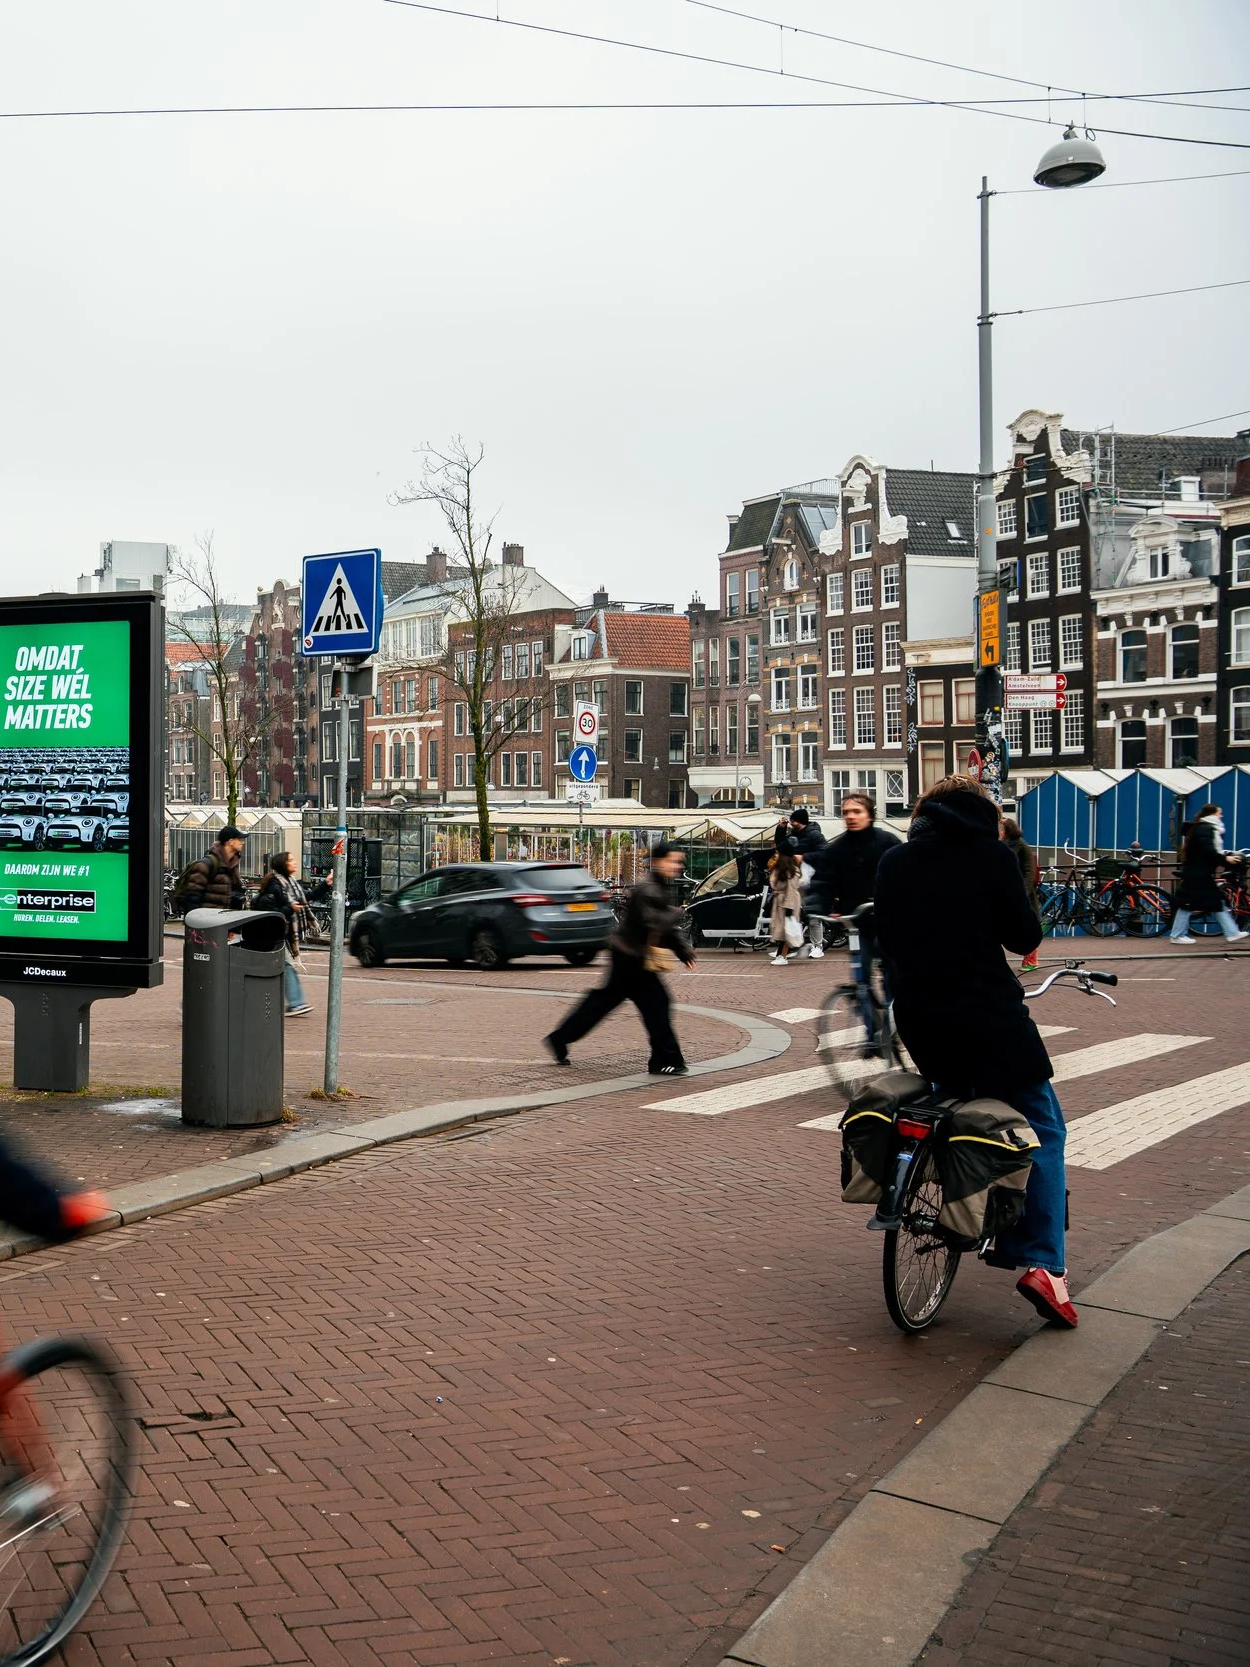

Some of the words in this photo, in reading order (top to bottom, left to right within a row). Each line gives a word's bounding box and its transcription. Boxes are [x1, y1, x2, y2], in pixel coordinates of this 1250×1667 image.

[15, 645, 84, 672] OMDAT
[4, 675, 47, 701] SIZE
[51, 667, 92, 700] WÉL
[4, 703, 93, 730] MATTERS
[582, 718, 593, 728] 30
[4, 864, 40, 875] DAAROM
[41, 864, 61, 875] ZIJN
[62, 865, 77, 876] WE
[77, 865, 90, 877] #1
[2, 894, 94, 909] enterprise
[14, 914, 35, 922] HUREN.
[35, 914, 56, 923] DELEN.
[56, 915, 80, 924] LEASEN.
[23, 966, 67, 977] JCDecaux
